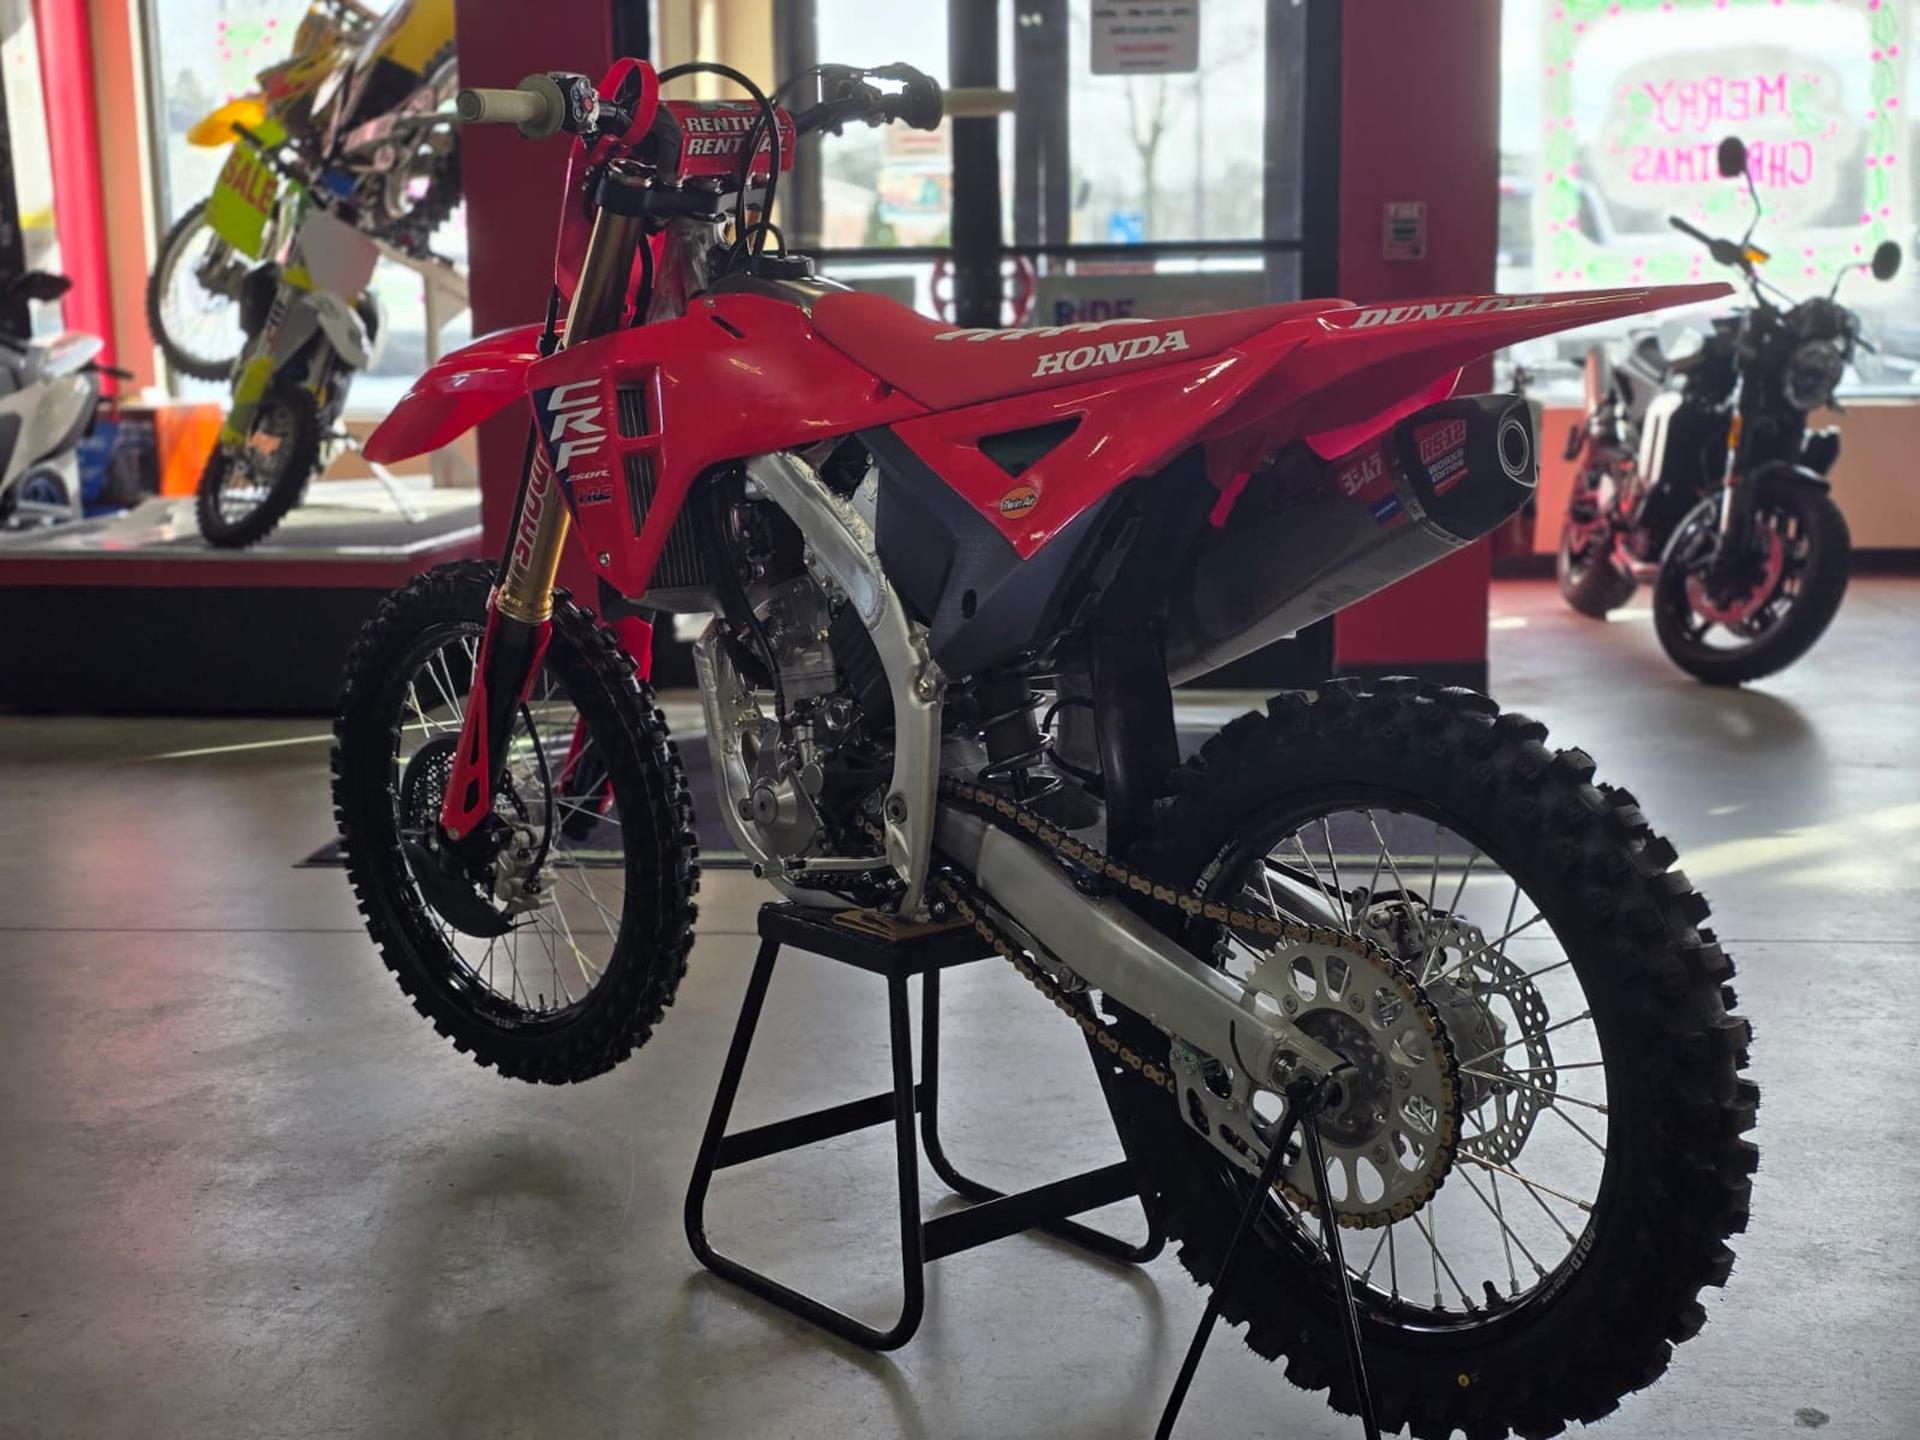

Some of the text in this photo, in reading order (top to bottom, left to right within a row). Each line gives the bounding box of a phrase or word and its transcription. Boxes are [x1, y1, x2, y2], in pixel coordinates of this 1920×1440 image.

[686, 117, 788, 132] RENTHL
[687, 138, 787, 155] RENTAL
[222, 151, 278, 215] SALE
[1032, 330, 1189, 377] HONDA
[547, 378, 608, 472] CRF
